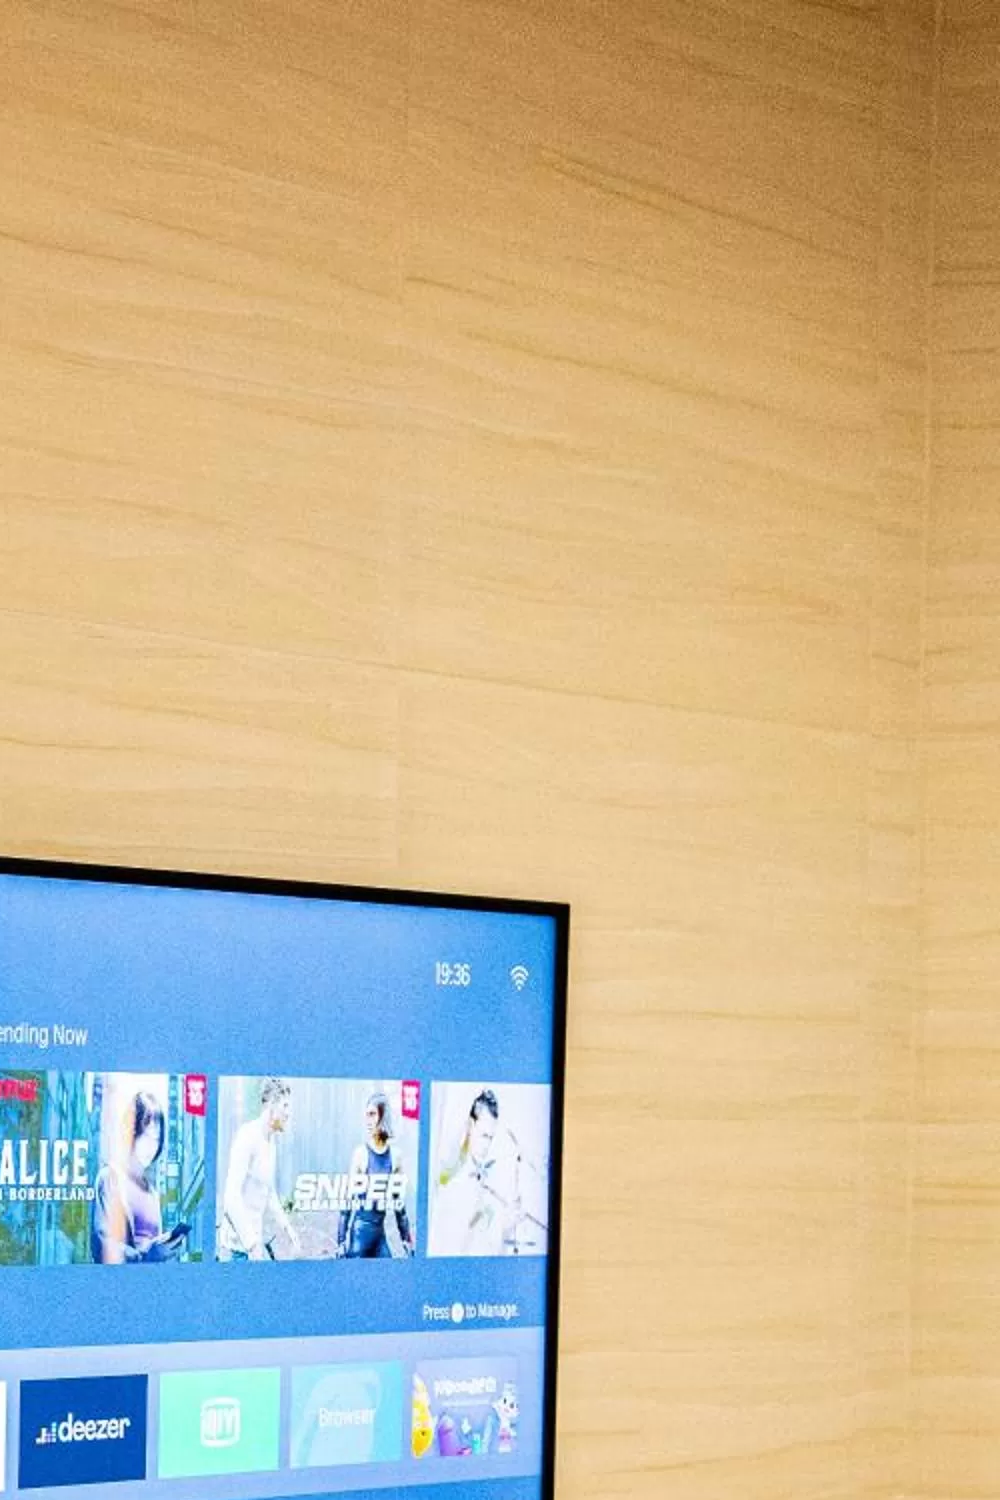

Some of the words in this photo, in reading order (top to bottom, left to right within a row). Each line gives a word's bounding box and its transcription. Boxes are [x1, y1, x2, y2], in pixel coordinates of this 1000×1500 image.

[435, 961, 471, 987] 19:36
[52, 1024, 88, 1045] Now
[9, 1186, 96, 1201] BORDERLAND
[293, 1173, 409, 1201] SNIPER
[423, 1304, 449, 1320] Press
[465, 1303, 477, 1319] to
[58, 1412, 131, 1443] deezer
